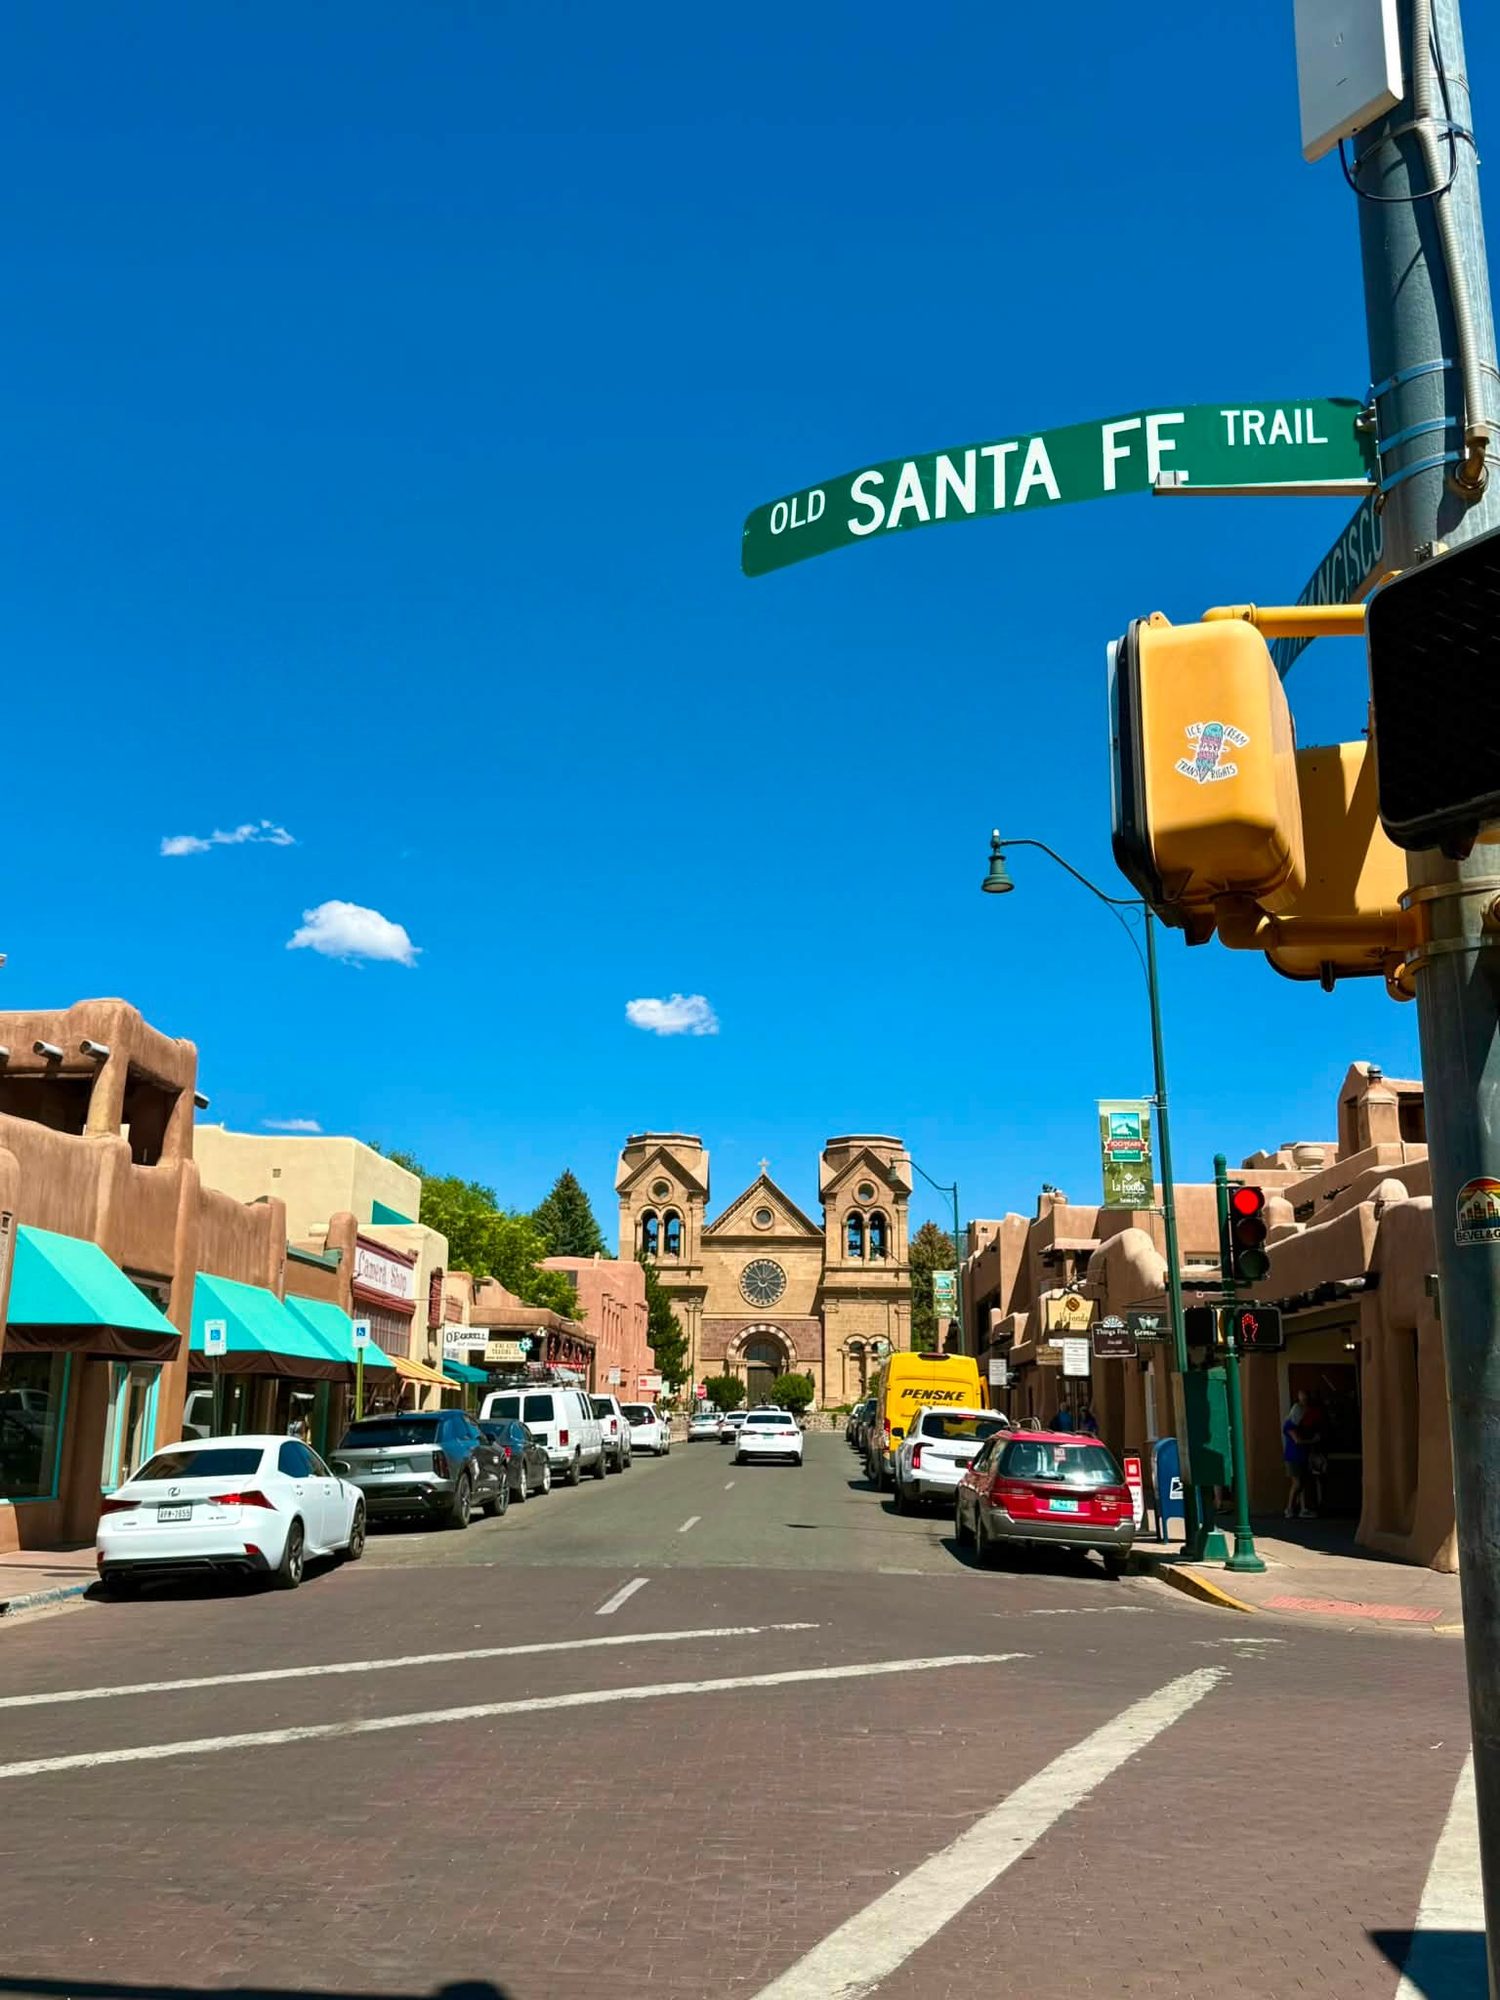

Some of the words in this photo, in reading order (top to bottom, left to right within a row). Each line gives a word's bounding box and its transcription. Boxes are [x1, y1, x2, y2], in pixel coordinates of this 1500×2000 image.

[770, 489, 826, 535] OLD
[847, 436, 1062, 536] SANTA
[1101, 411, 1189, 491] FE
[1220, 407, 1329, 446] TRAIL
[1187, 724, 1202, 737] ICE
[1223, 726, 1248, 746] CREAM
[1177, 760, 1199, 778] TRANS
[1210, 765, 1236, 780] RIGHTS
[1112, 1179, 1121, 1192] La
[1122, 1179, 1146, 1194] Fonda
[901, 1388, 966, 1401] PENSKE
